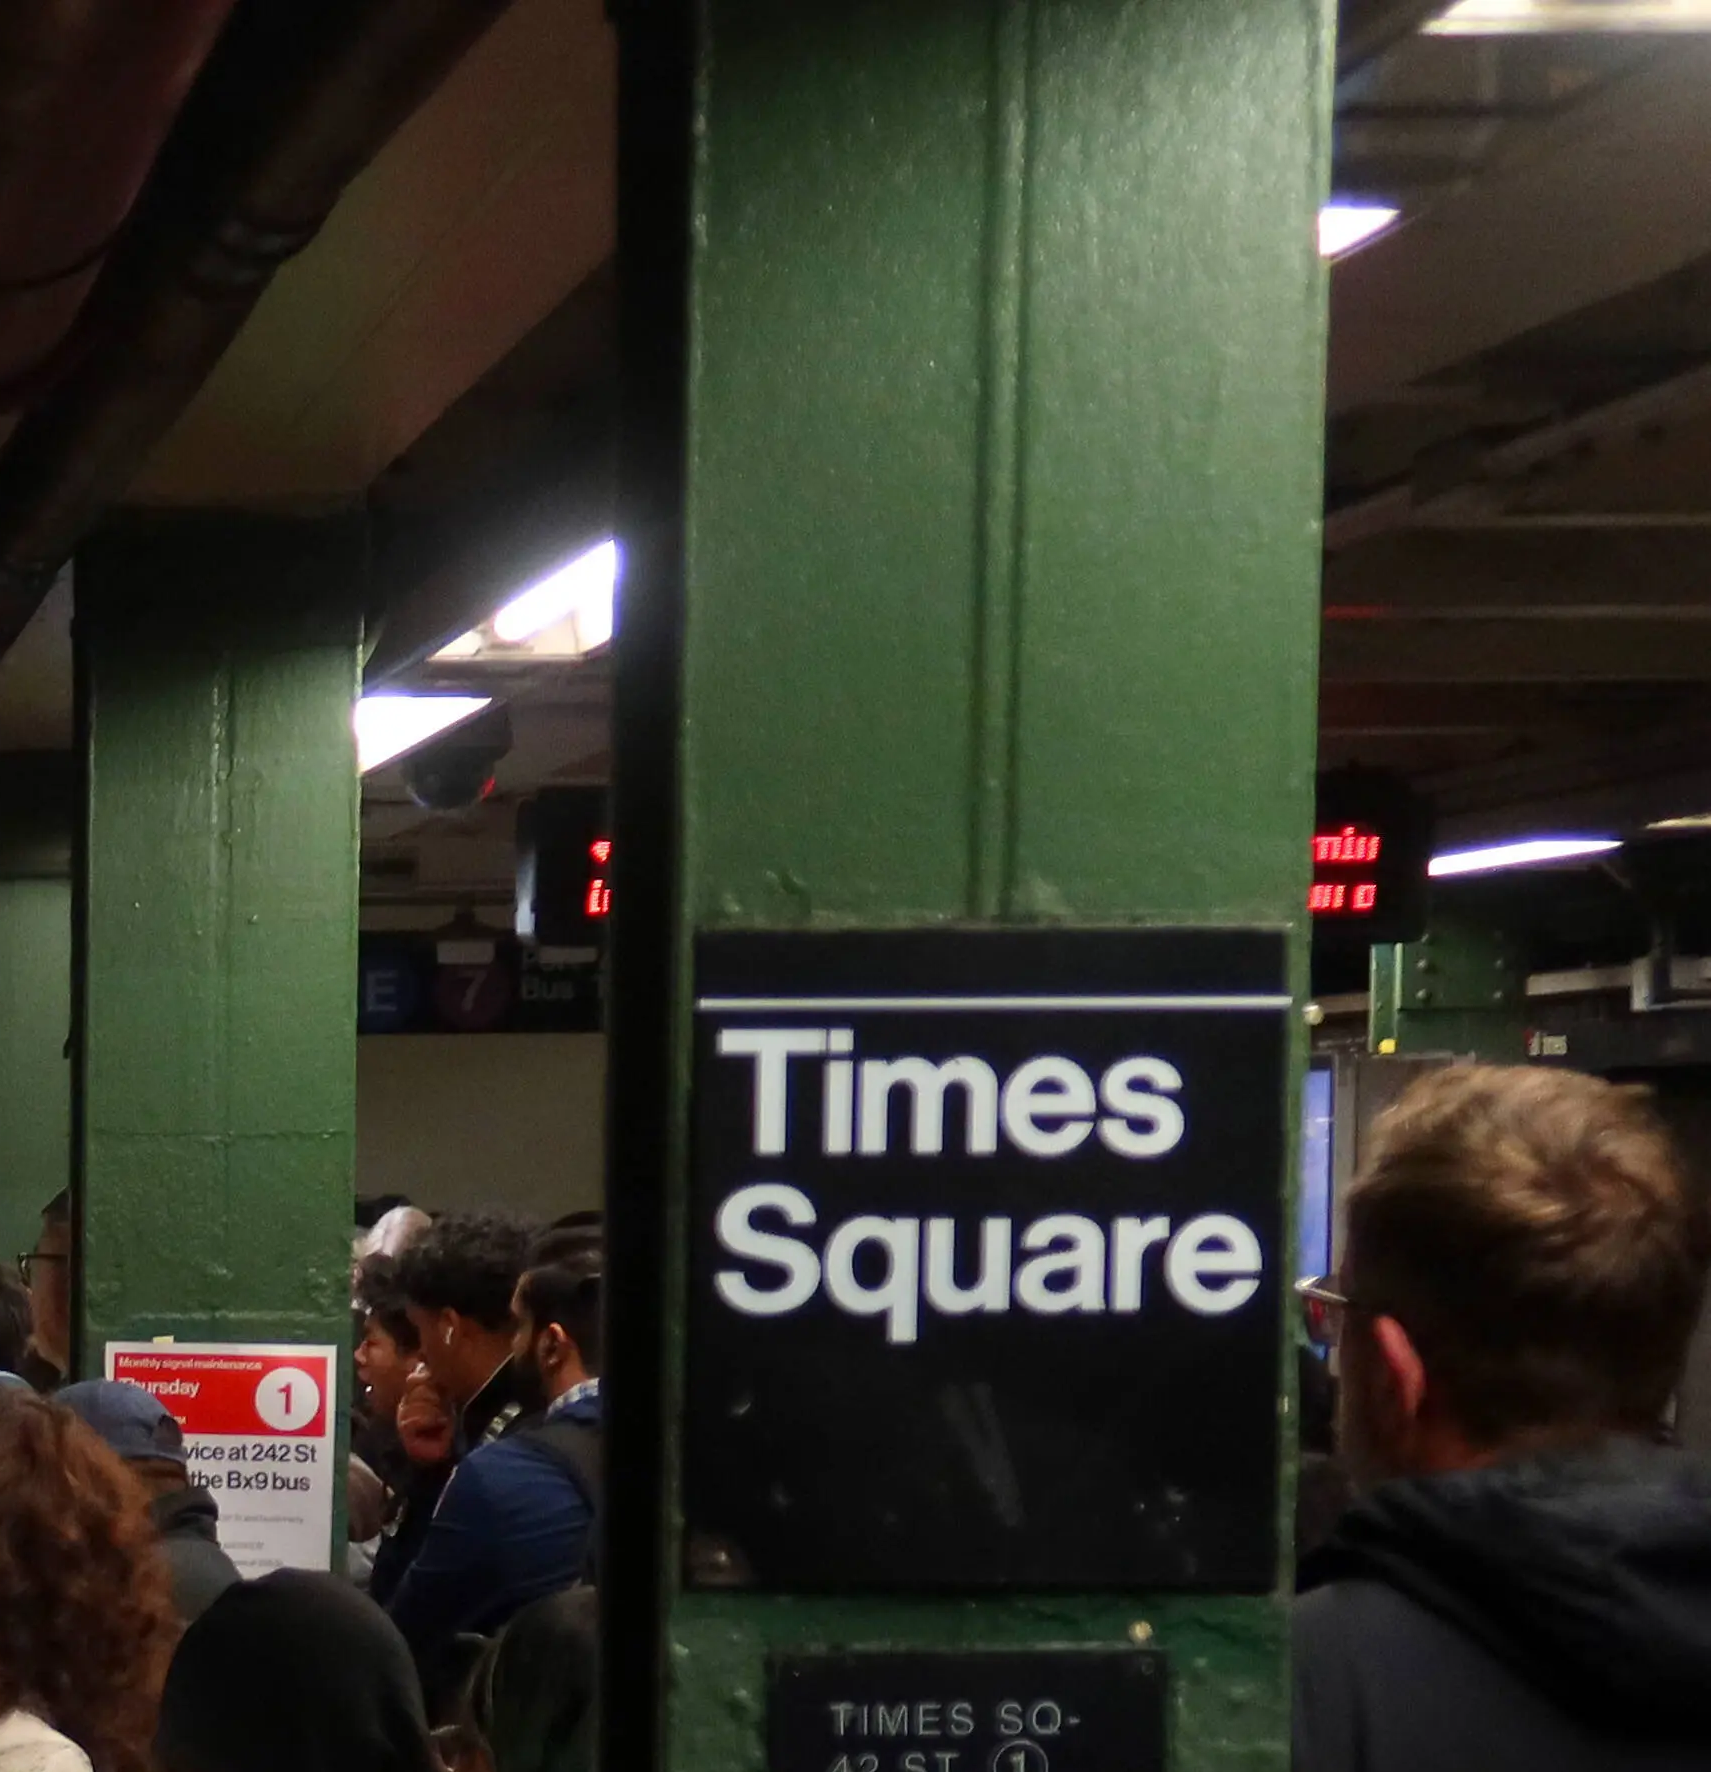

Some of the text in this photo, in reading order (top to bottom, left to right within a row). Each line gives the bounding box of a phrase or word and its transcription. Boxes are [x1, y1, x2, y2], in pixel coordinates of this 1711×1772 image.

[365, 970, 399, 1013] E
[456, 970, 488, 1013] 7
[716, 1027, 1186, 1157] Times
[714, 1183, 1264, 1343] Square
[119, 1356, 263, 1371] Monthly signal maintenance
[277, 1382, 293, 1415] 1
[184, 1441, 317, 1463] vice at 242 St
[227, 1470, 268, 1490] Bx9
[272, 1472, 310, 1491] bus
[831, 1702, 975, 1736] TIMES
